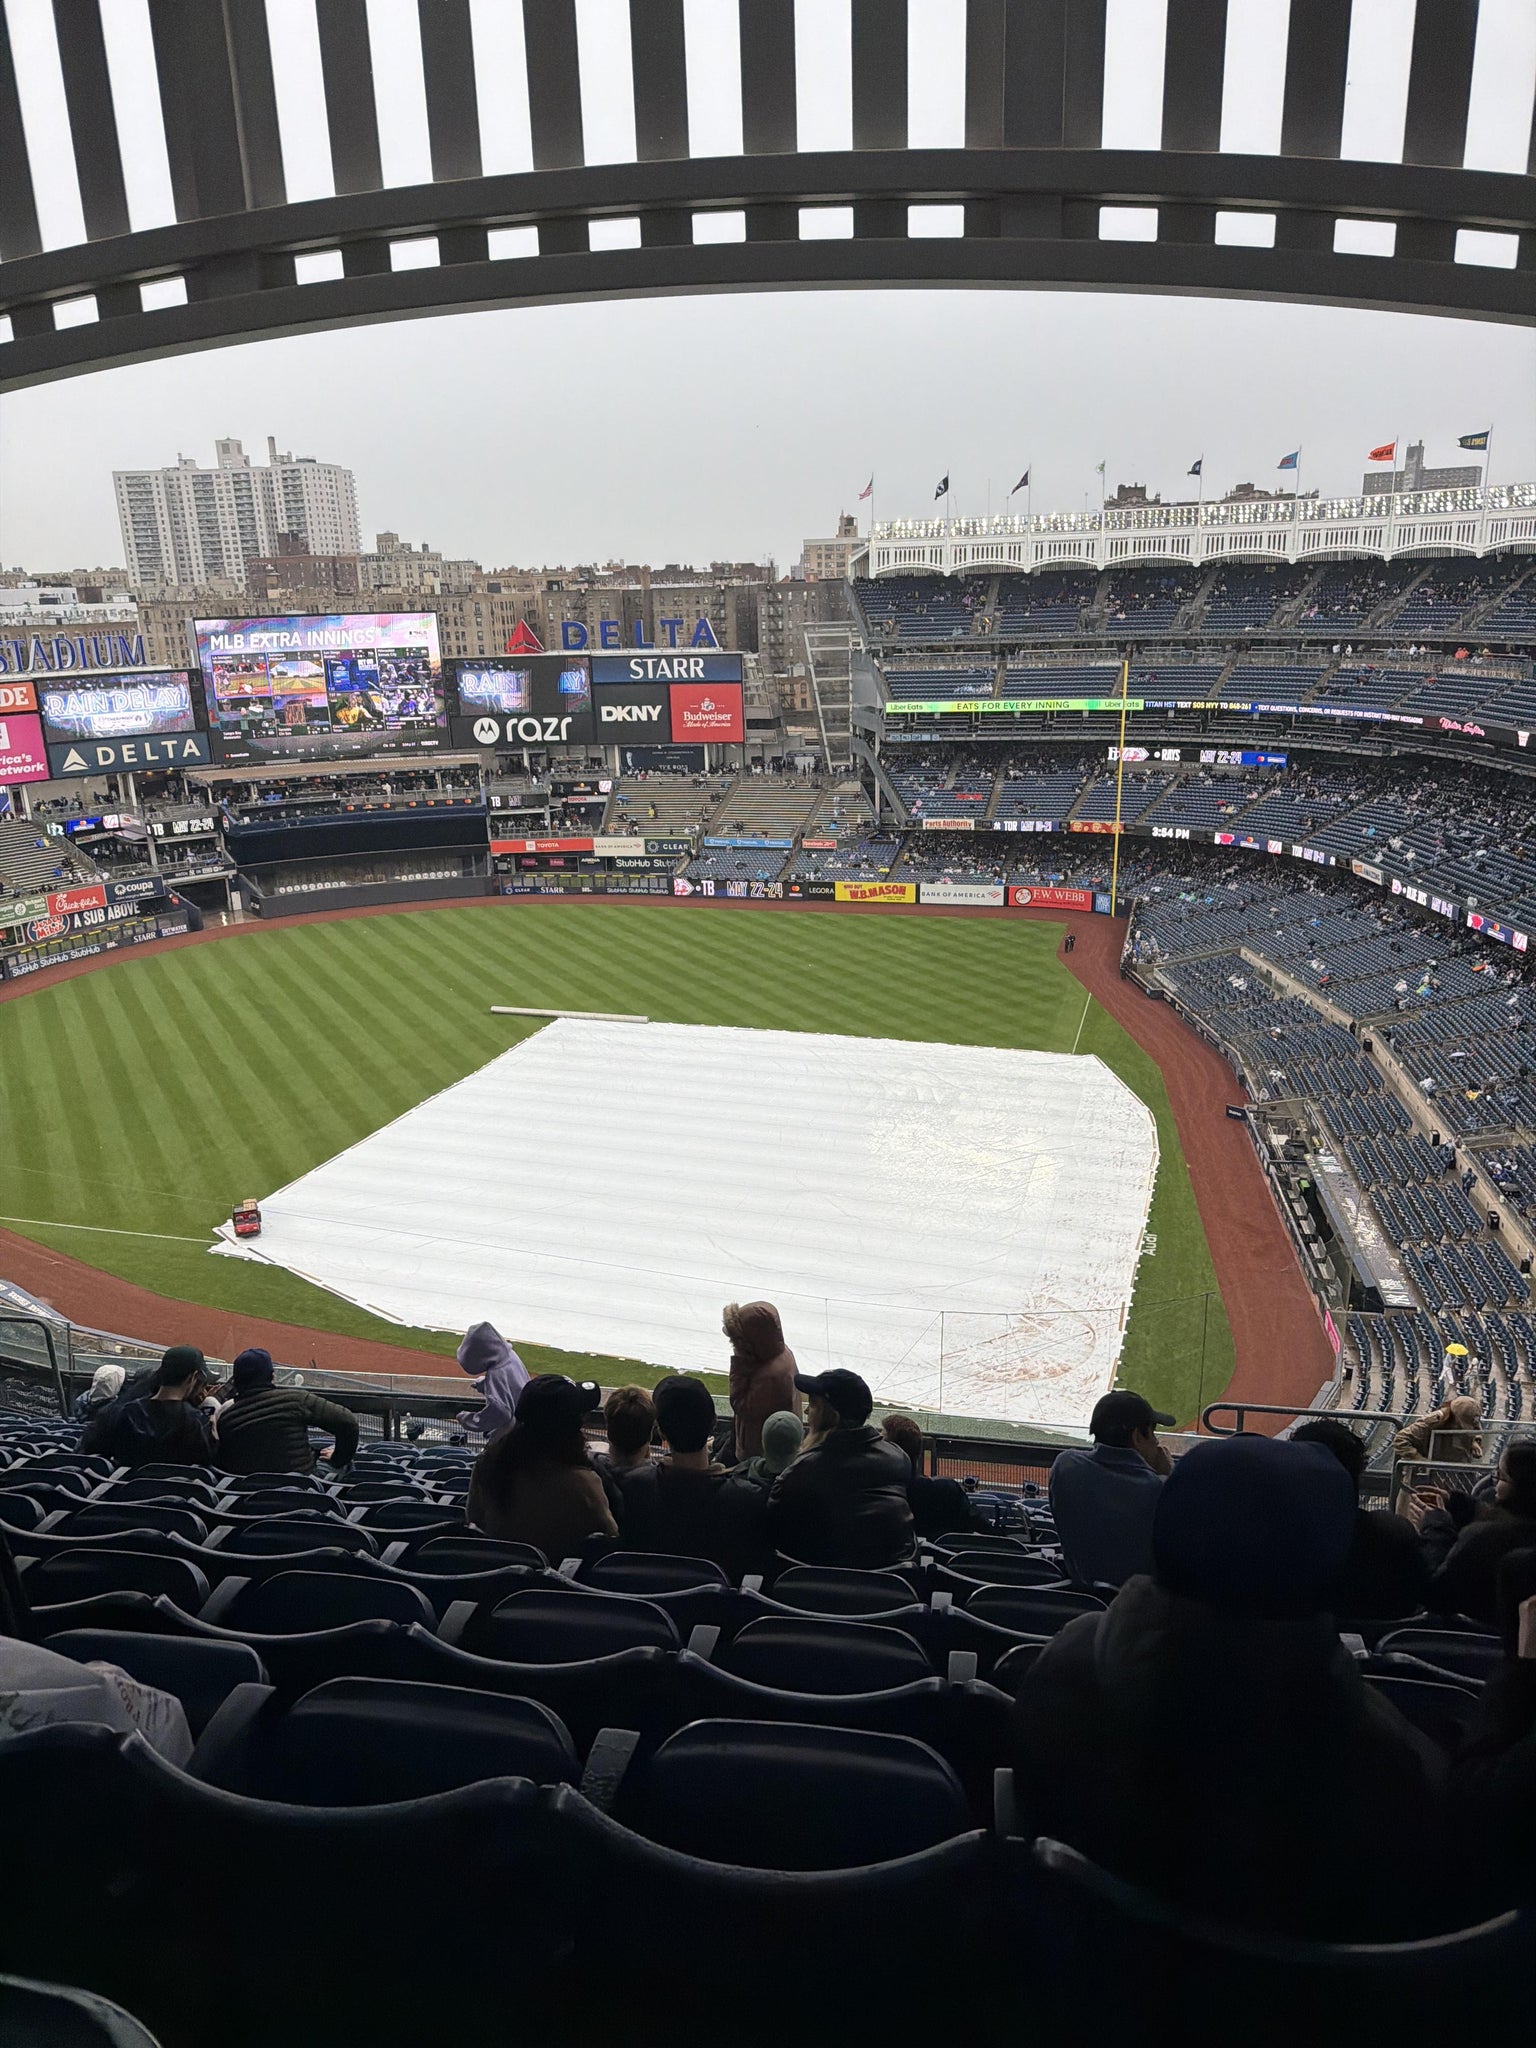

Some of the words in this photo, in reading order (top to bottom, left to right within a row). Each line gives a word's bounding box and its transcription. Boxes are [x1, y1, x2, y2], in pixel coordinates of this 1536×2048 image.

[210, 635, 244, 650] MLB
[250, 631, 302, 648] EXTRA
[308, 628, 376, 646] INNINGS
[562, 618, 718, 650] DELTA
[630, 658, 705, 679] STARR
[463, 673, 516, 692] RAIN
[50, 692, 108, 716] RAIN
[114, 687, 181, 712] DELAY
[601, 705, 662, 722] DKNY
[684, 712, 732, 721] Budweiser
[506, 717, 572, 742] razr
[96, 738, 200, 766] DELTA
[1162, 749, 1181, 761] RAYS
[490, 796, 501, 807] TB
[943, 820, 972, 829] Authority
[1004, 821, 1018, 831] TOR
[1152, 827, 1174, 838] 3:54
[1176, 828, 1190, 840] PM
[616, 859, 650, 868] StubHub
[126, 881, 153, 892] coupa
[701, 880, 715, 896] TB
[727, 881, 748, 897] MAY
[750, 881, 783, 898] 22-24
[1033, 889, 1052, 899] F.W.
[1054, 890, 1085, 902] WEBB
[74, 914, 81, 928] A
[83, 908, 105, 926] SUB
[108, 901, 140, 920] ABOVE
[133, 932, 156, 943] STARR
[12, 962, 39, 977] StubHub
[40, 954, 68, 968] StubHub
[70, 945, 100, 959] StubHub
[1142, 1234, 1158, 1256] Audi
